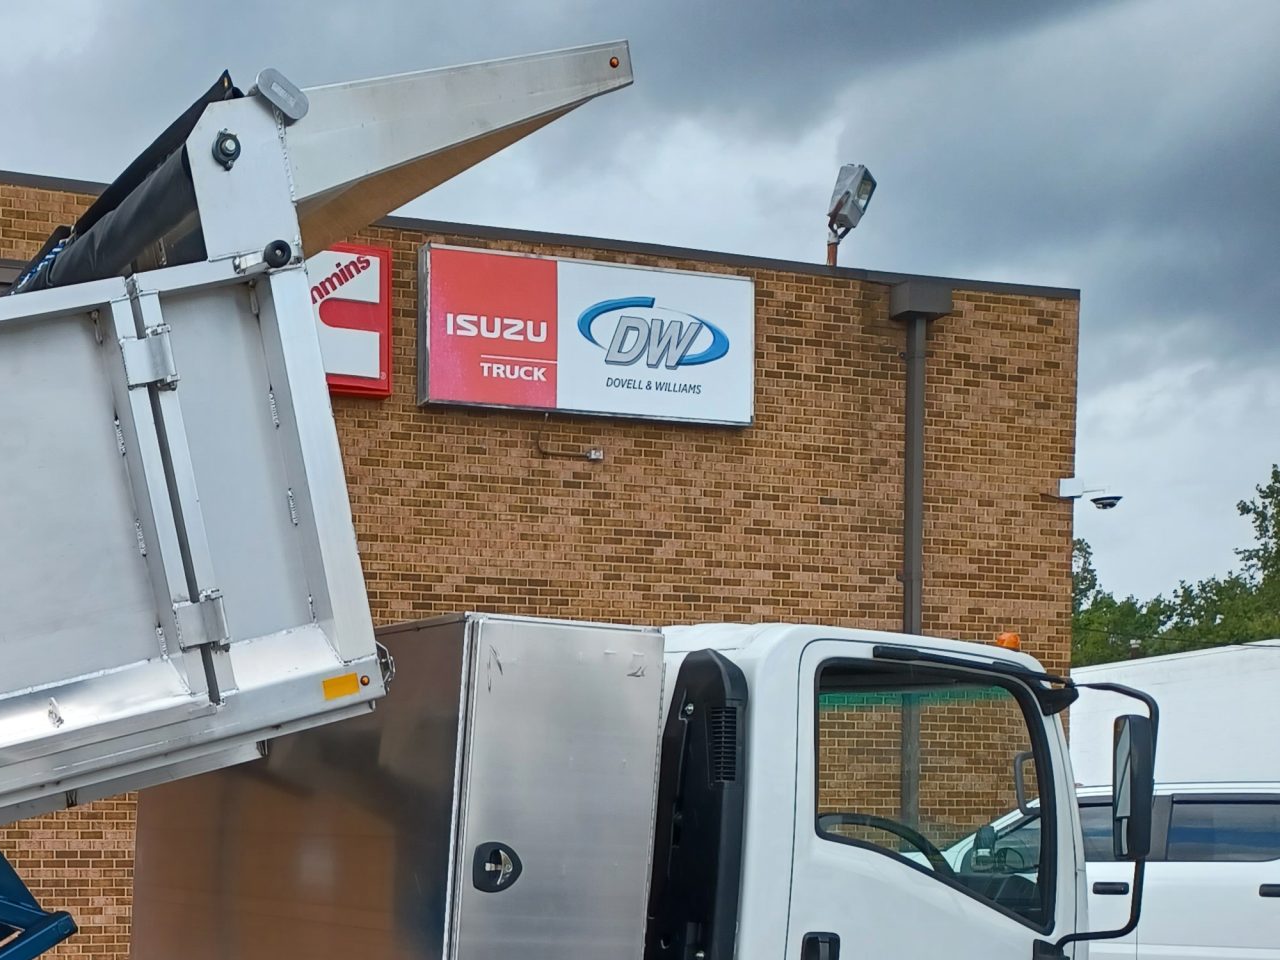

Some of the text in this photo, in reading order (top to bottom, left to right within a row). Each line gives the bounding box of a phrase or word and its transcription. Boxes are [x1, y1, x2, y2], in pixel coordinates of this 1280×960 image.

[446, 312, 548, 343] ISUZU
[605, 315, 704, 370] DW
[480, 362, 547, 382] TRUCK
[606, 376, 702, 395] DOVELL & WILLIAMS
